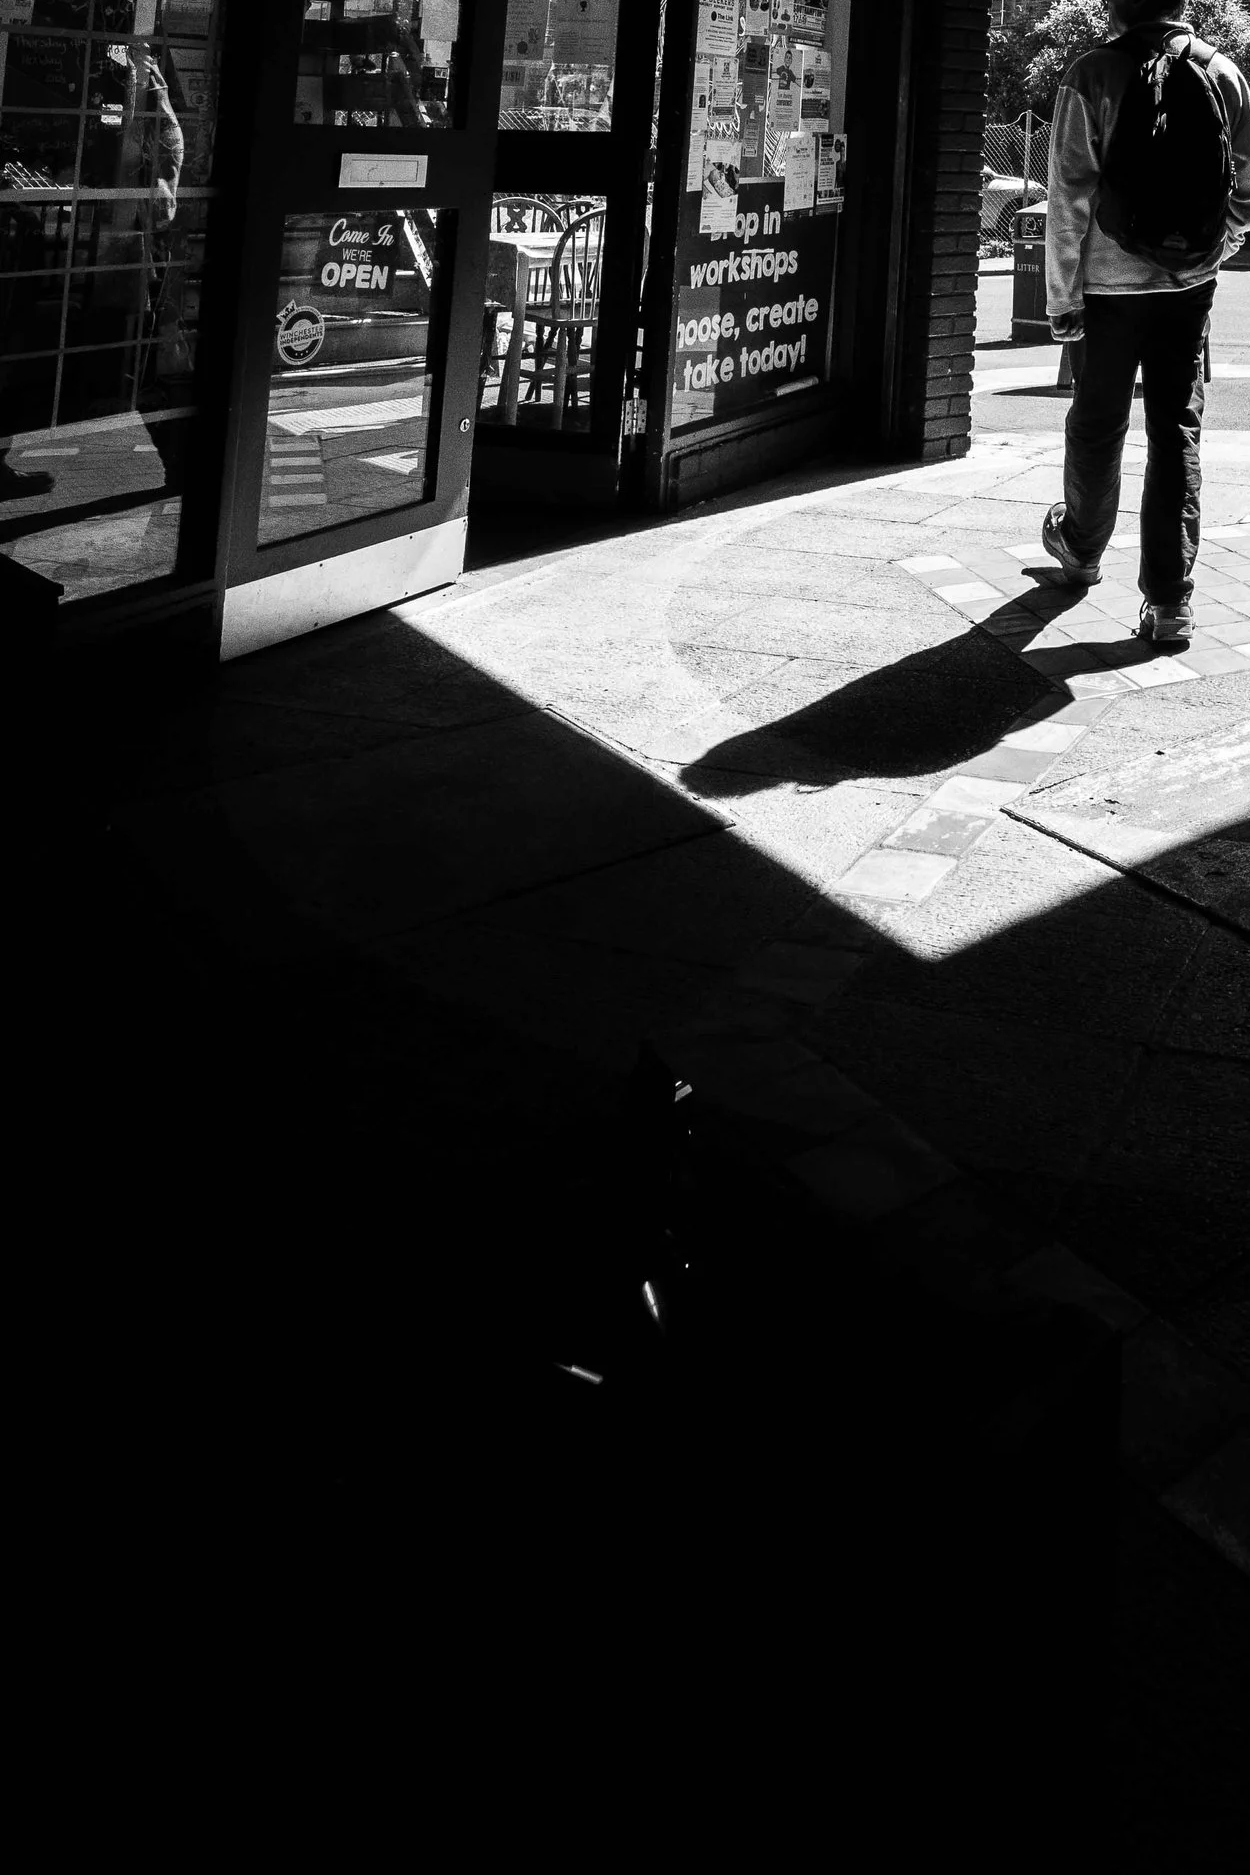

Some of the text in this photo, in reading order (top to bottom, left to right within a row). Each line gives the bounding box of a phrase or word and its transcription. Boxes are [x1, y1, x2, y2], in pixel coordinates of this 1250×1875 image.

[328, 218, 395, 246] Come In
[711, 204, 781, 244] op in
[342, 247, 373, 263] WE'RE
[690, 248, 799, 290] workshops
[1016, 263, 1040, 274] LITTER
[320, 261, 389, 290] OPEN
[745, 293, 819, 333] create
[279, 324, 323, 340] WINCHESTER
[279, 332, 323, 346] INDEPENDENTS
[683, 333, 807, 393] take today!
